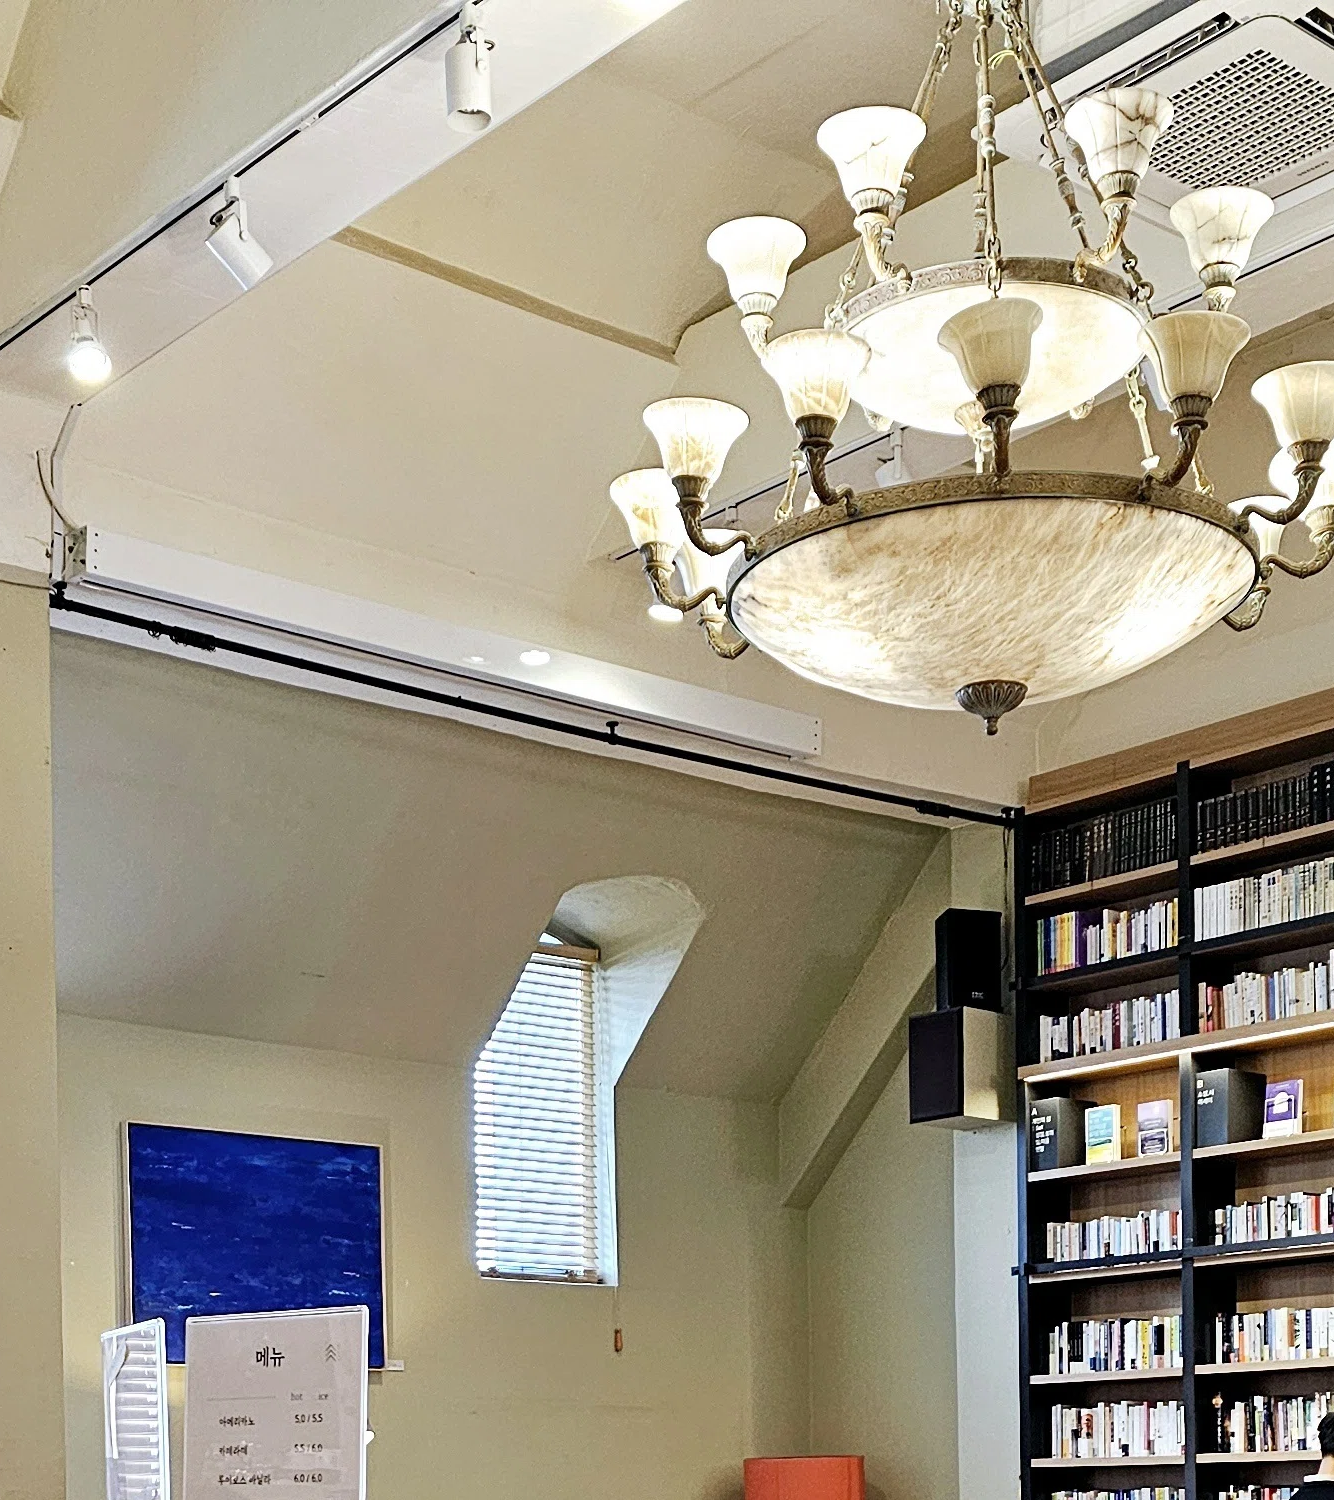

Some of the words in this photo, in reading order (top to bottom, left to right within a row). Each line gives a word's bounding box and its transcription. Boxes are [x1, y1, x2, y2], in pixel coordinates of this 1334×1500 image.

[255, 1347, 285, 1367] 메뉴
[219, 1417, 255, 1426] 아메리카노
[295, 1414, 306, 1423] 5.0
[312, 1414, 323, 1422] 5.5
[293, 1475, 305, 1483] 6.0
[311, 1474, 322, 1483] 6.0
